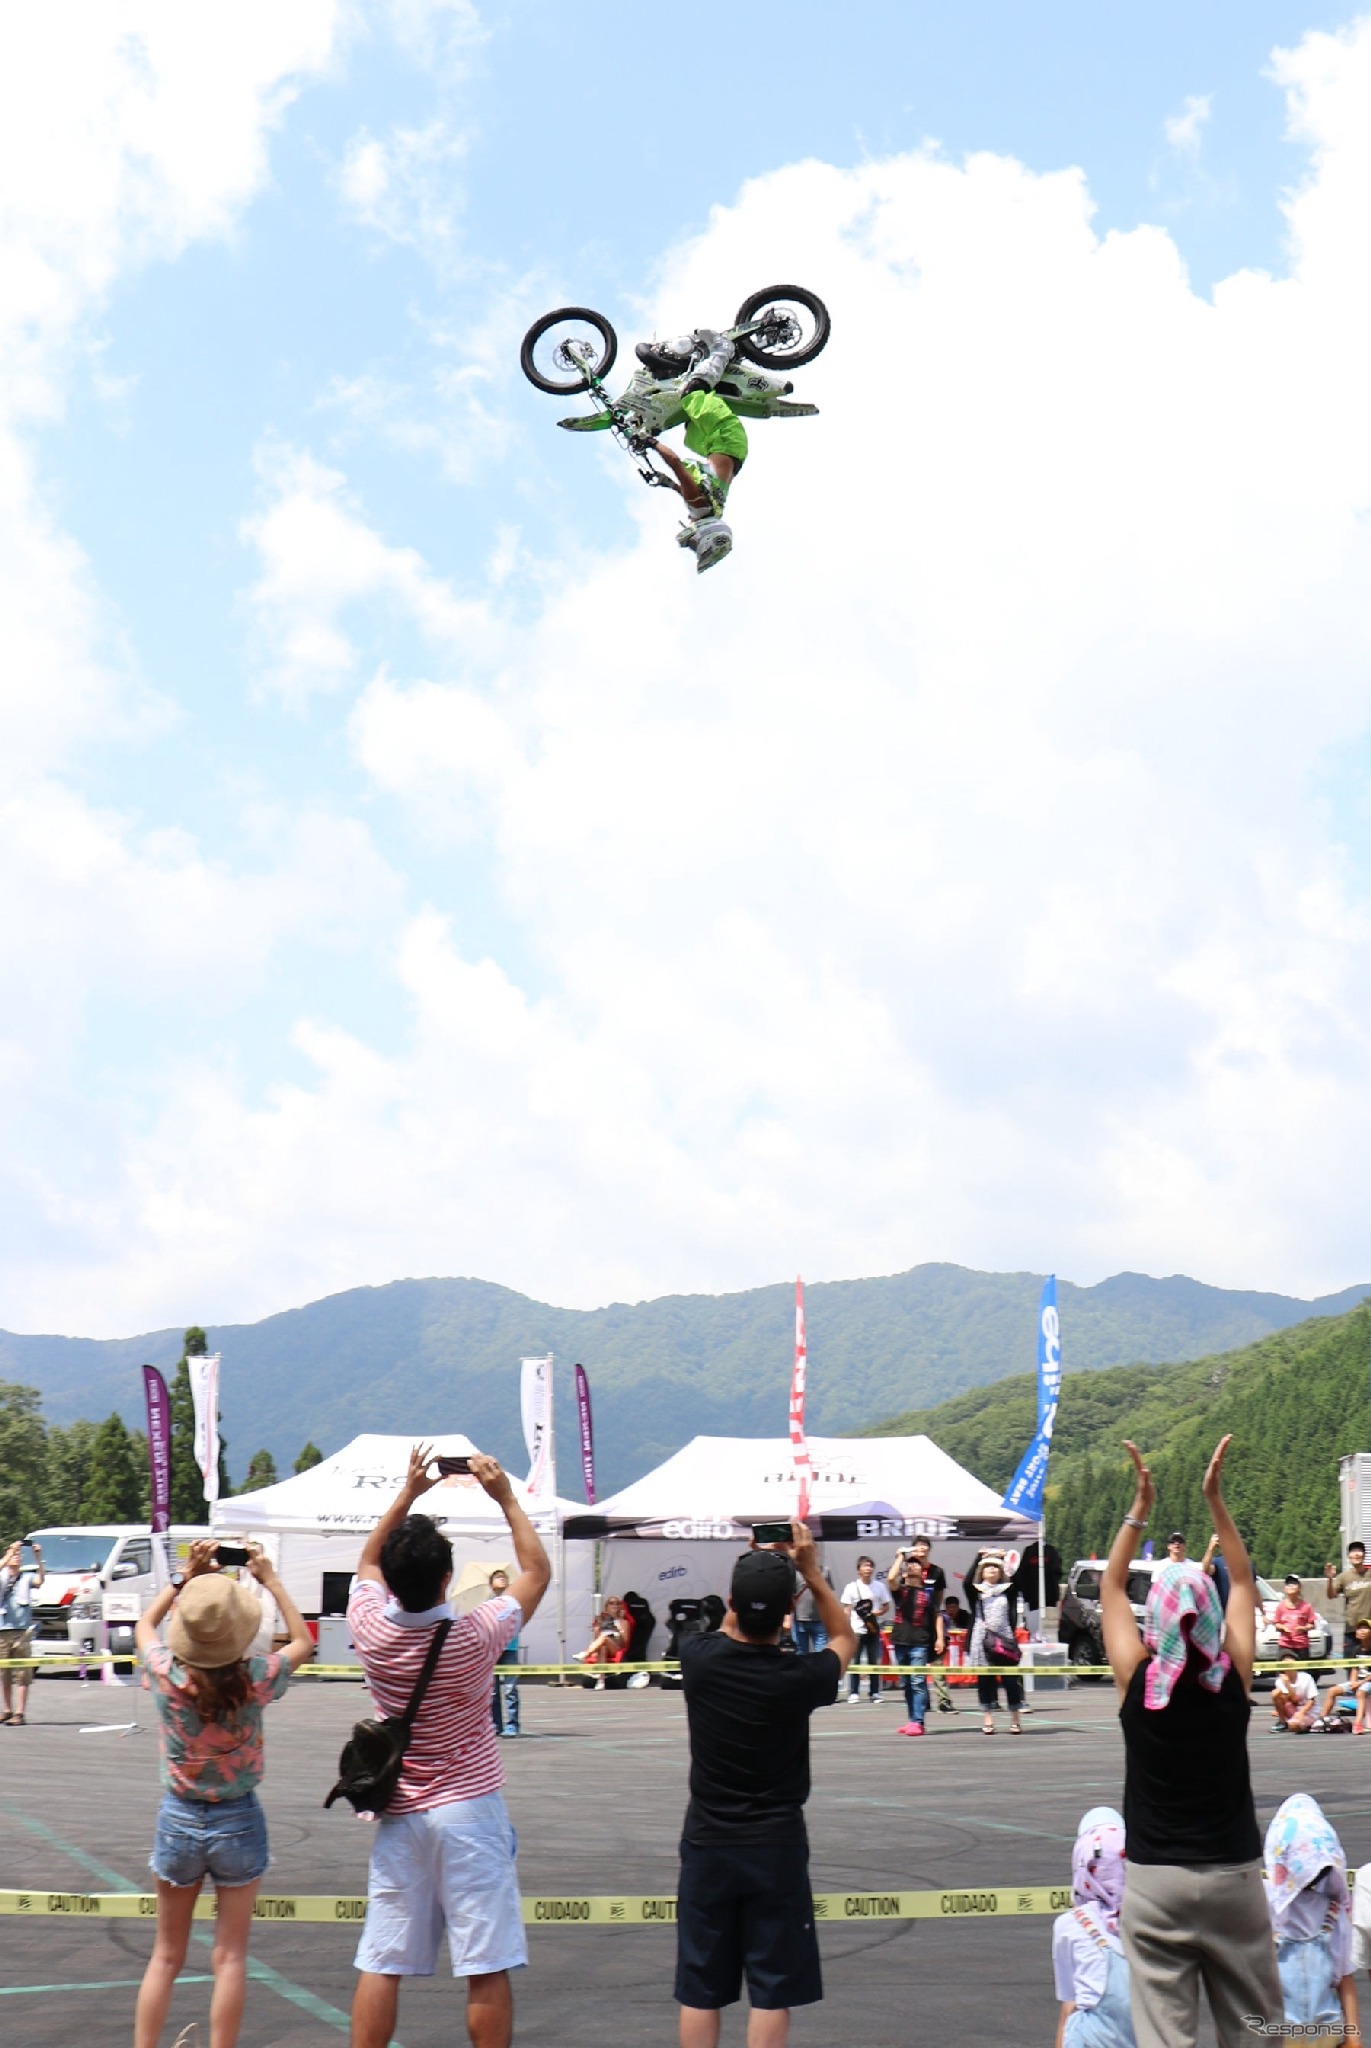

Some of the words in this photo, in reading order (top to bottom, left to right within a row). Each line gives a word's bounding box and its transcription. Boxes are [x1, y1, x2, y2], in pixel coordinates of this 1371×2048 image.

[856, 1518, 960, 1537] BRIDE
[48, 1894, 101, 1914] CAUTION
[251, 1899, 297, 1918] AUTION
[335, 1900, 368, 1919] CUID
[535, 1901, 590, 1920] CUIDADO
[642, 1900, 677, 1920] CAUT
[844, 1897, 900, 1916] CAUTION
[941, 1894, 998, 1914] CUIDADO
